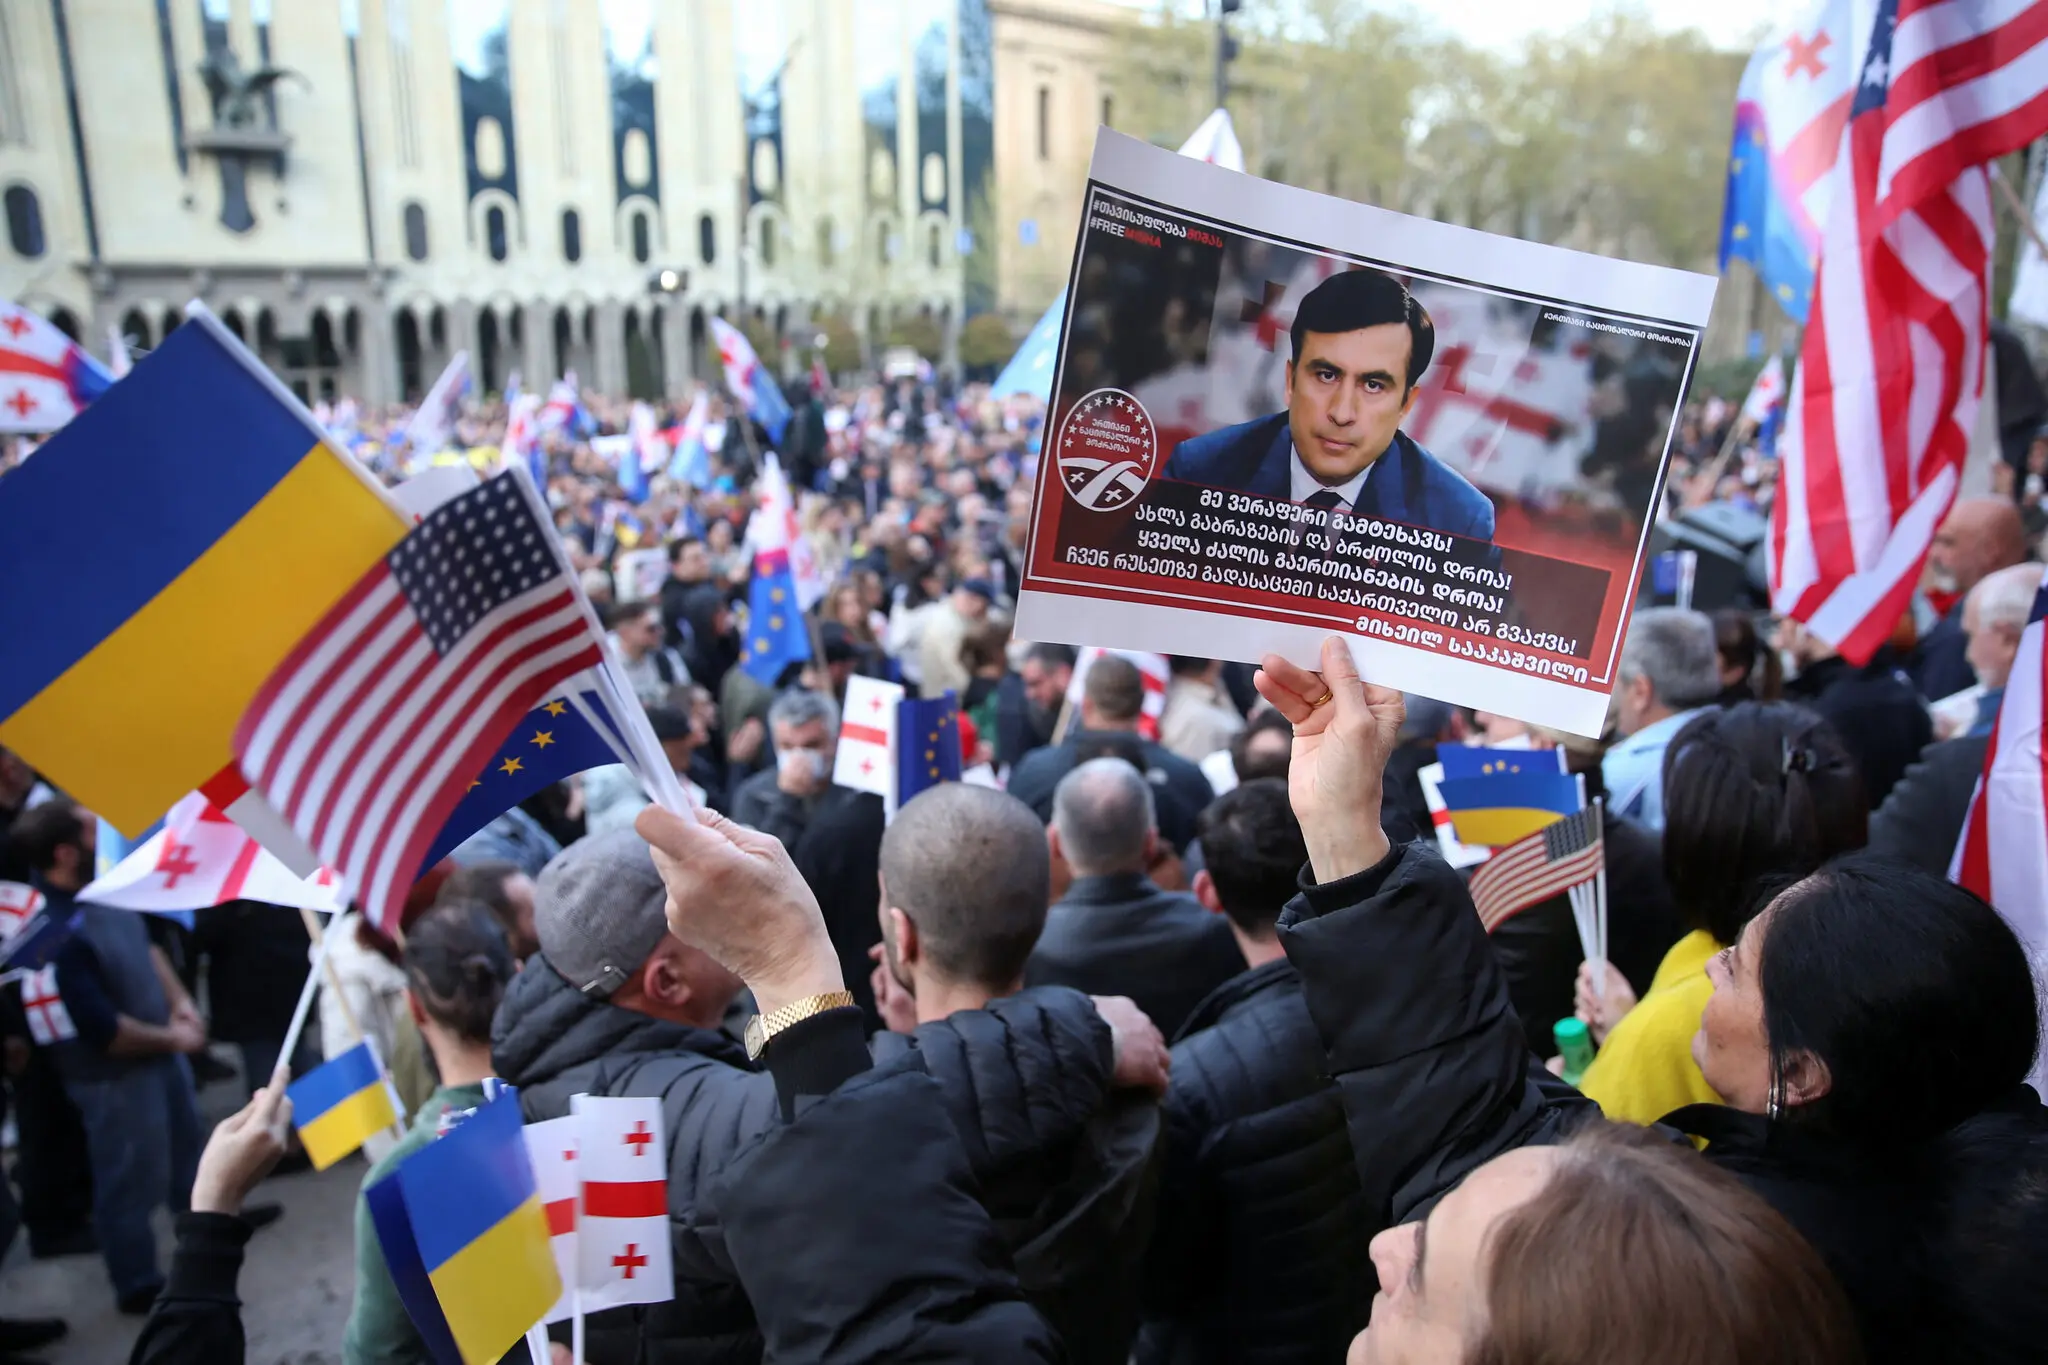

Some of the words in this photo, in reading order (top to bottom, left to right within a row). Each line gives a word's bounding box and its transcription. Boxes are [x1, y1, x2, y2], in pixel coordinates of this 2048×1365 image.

[1134, 504, 1186, 527] ახლა
[1190, 513, 1300, 547] გაბრაზების
[1305, 532, 1331, 552] და
[1335, 538, 1438, 574] ბრძოლის
[1443, 559, 1513, 591] დროა!
[1200, 489, 1222, 508] მე
[1227, 494, 1328, 528] ვერაფერი
[1332, 514, 1454, 553] გამტეხავს!
[1066, 546, 1110, 568] ჩვენ
[1113, 553, 1199, 580] რუსეთზე
[1201, 565, 1315, 598] გადასაცემი
[1317, 583, 1459, 629] საქართველო
[1462, 615, 1491, 637] არ
[1495, 622, 1578, 656] გვაქვს!
[1137, 530, 1201, 556] ყველა
[1205, 541, 1269, 566] ძალის
[1274, 552, 1426, 596] გაერთიანების
[1432, 582, 1504, 614] დროა!
[1355, 616, 1444, 647] მიხეილ
[1448, 637, 1589, 685] სააკაშვილი
